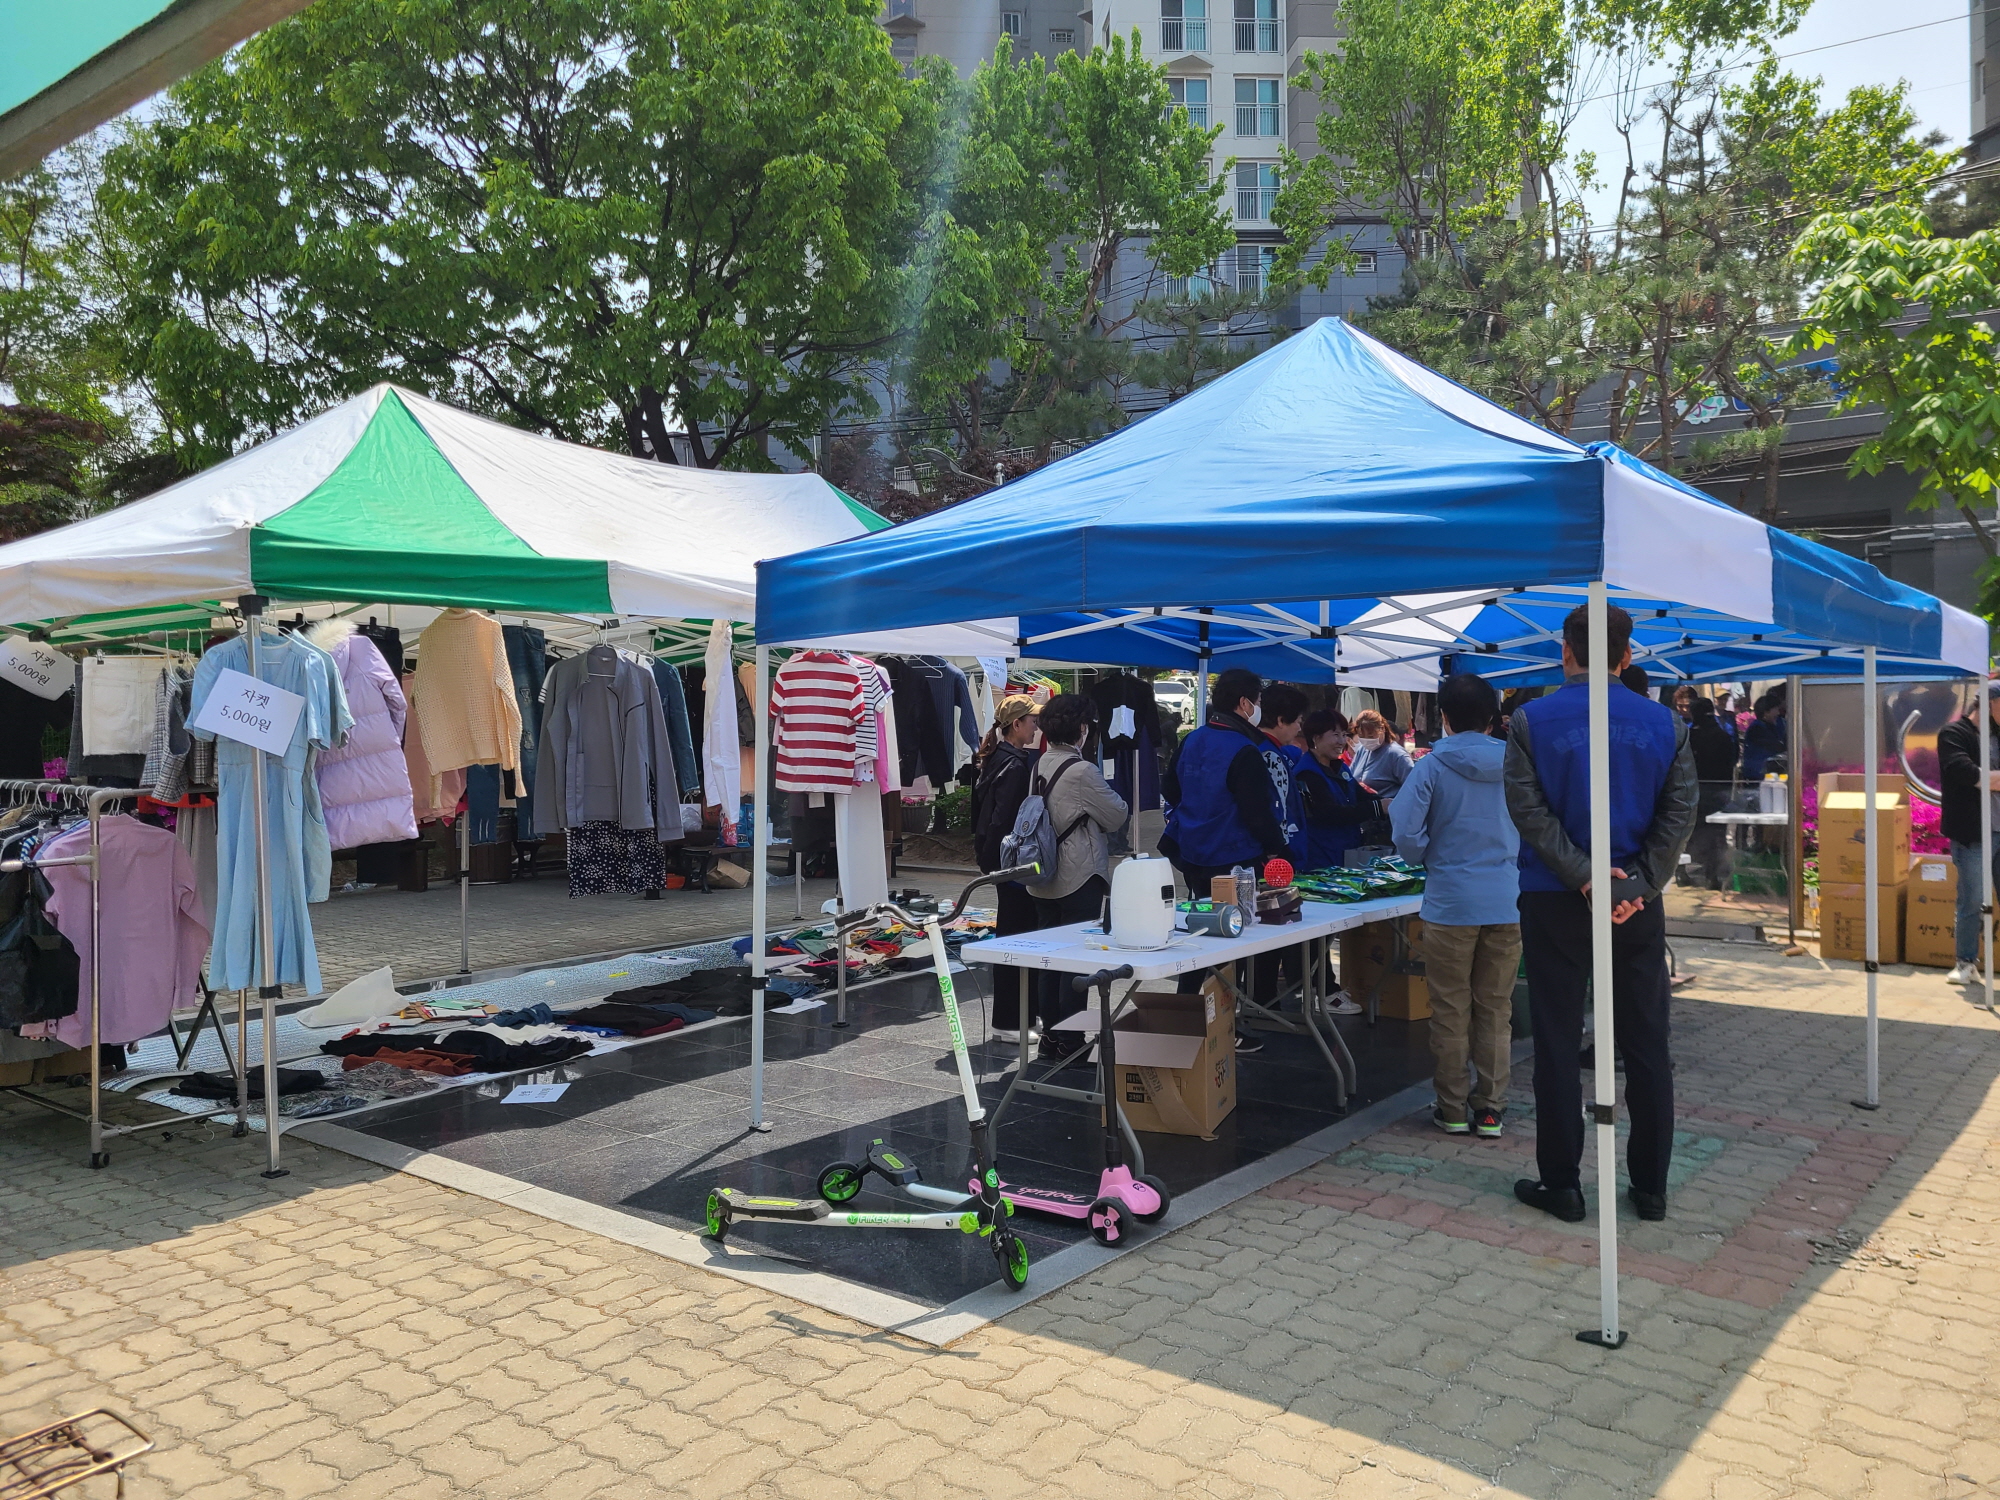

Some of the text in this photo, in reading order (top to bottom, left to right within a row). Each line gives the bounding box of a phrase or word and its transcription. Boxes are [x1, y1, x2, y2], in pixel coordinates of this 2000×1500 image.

[31, 649, 56, 669] 자켓
[241, 688, 270, 710] 자켓
[1002, 952, 1052, 968] 와 동
